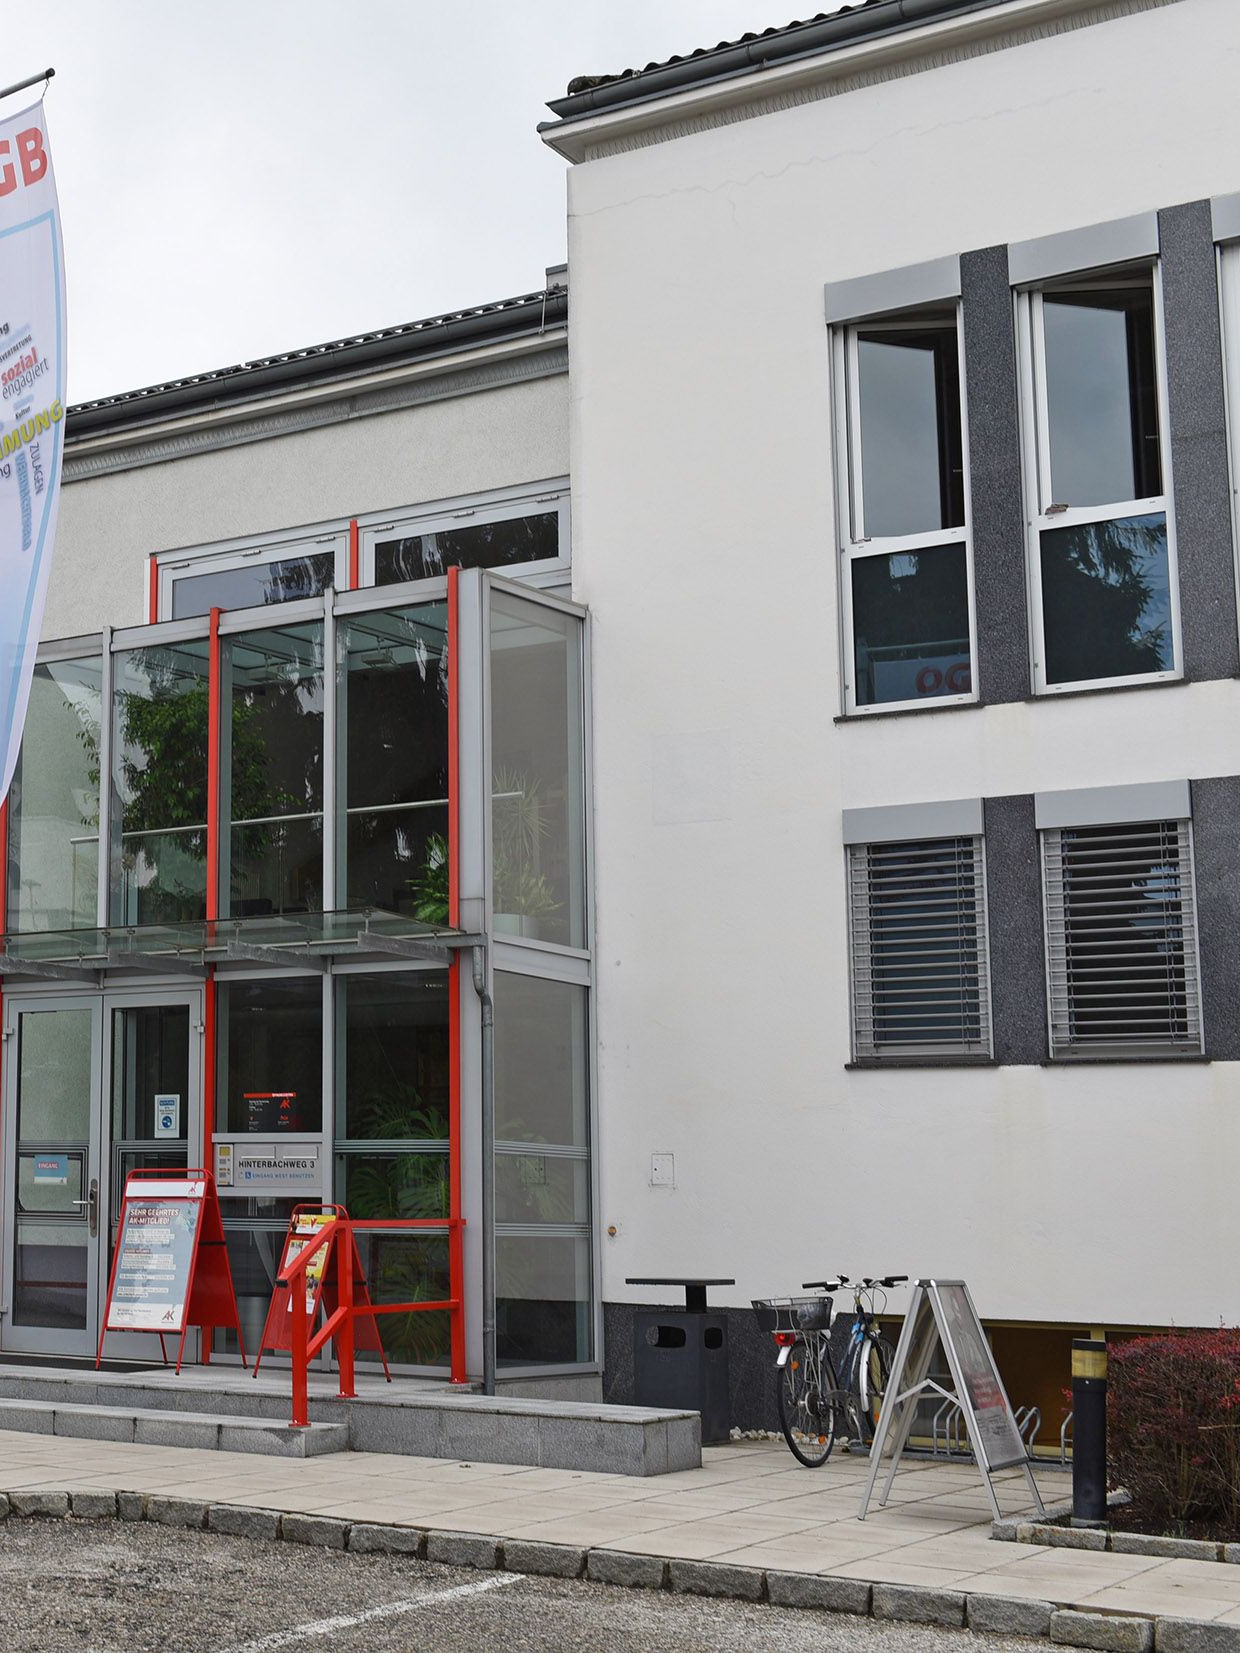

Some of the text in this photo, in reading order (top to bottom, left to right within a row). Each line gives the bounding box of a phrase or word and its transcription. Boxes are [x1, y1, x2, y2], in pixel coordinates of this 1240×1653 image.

[1, 346, 39, 386] sozial
[2, 357, 49, 400] engagiert
[29, 441, 44, 496] ZULAGEN
[238, 1160, 315, 1169] HINTERBACHWEG 3
[162, 1310, 175, 1321] AK
